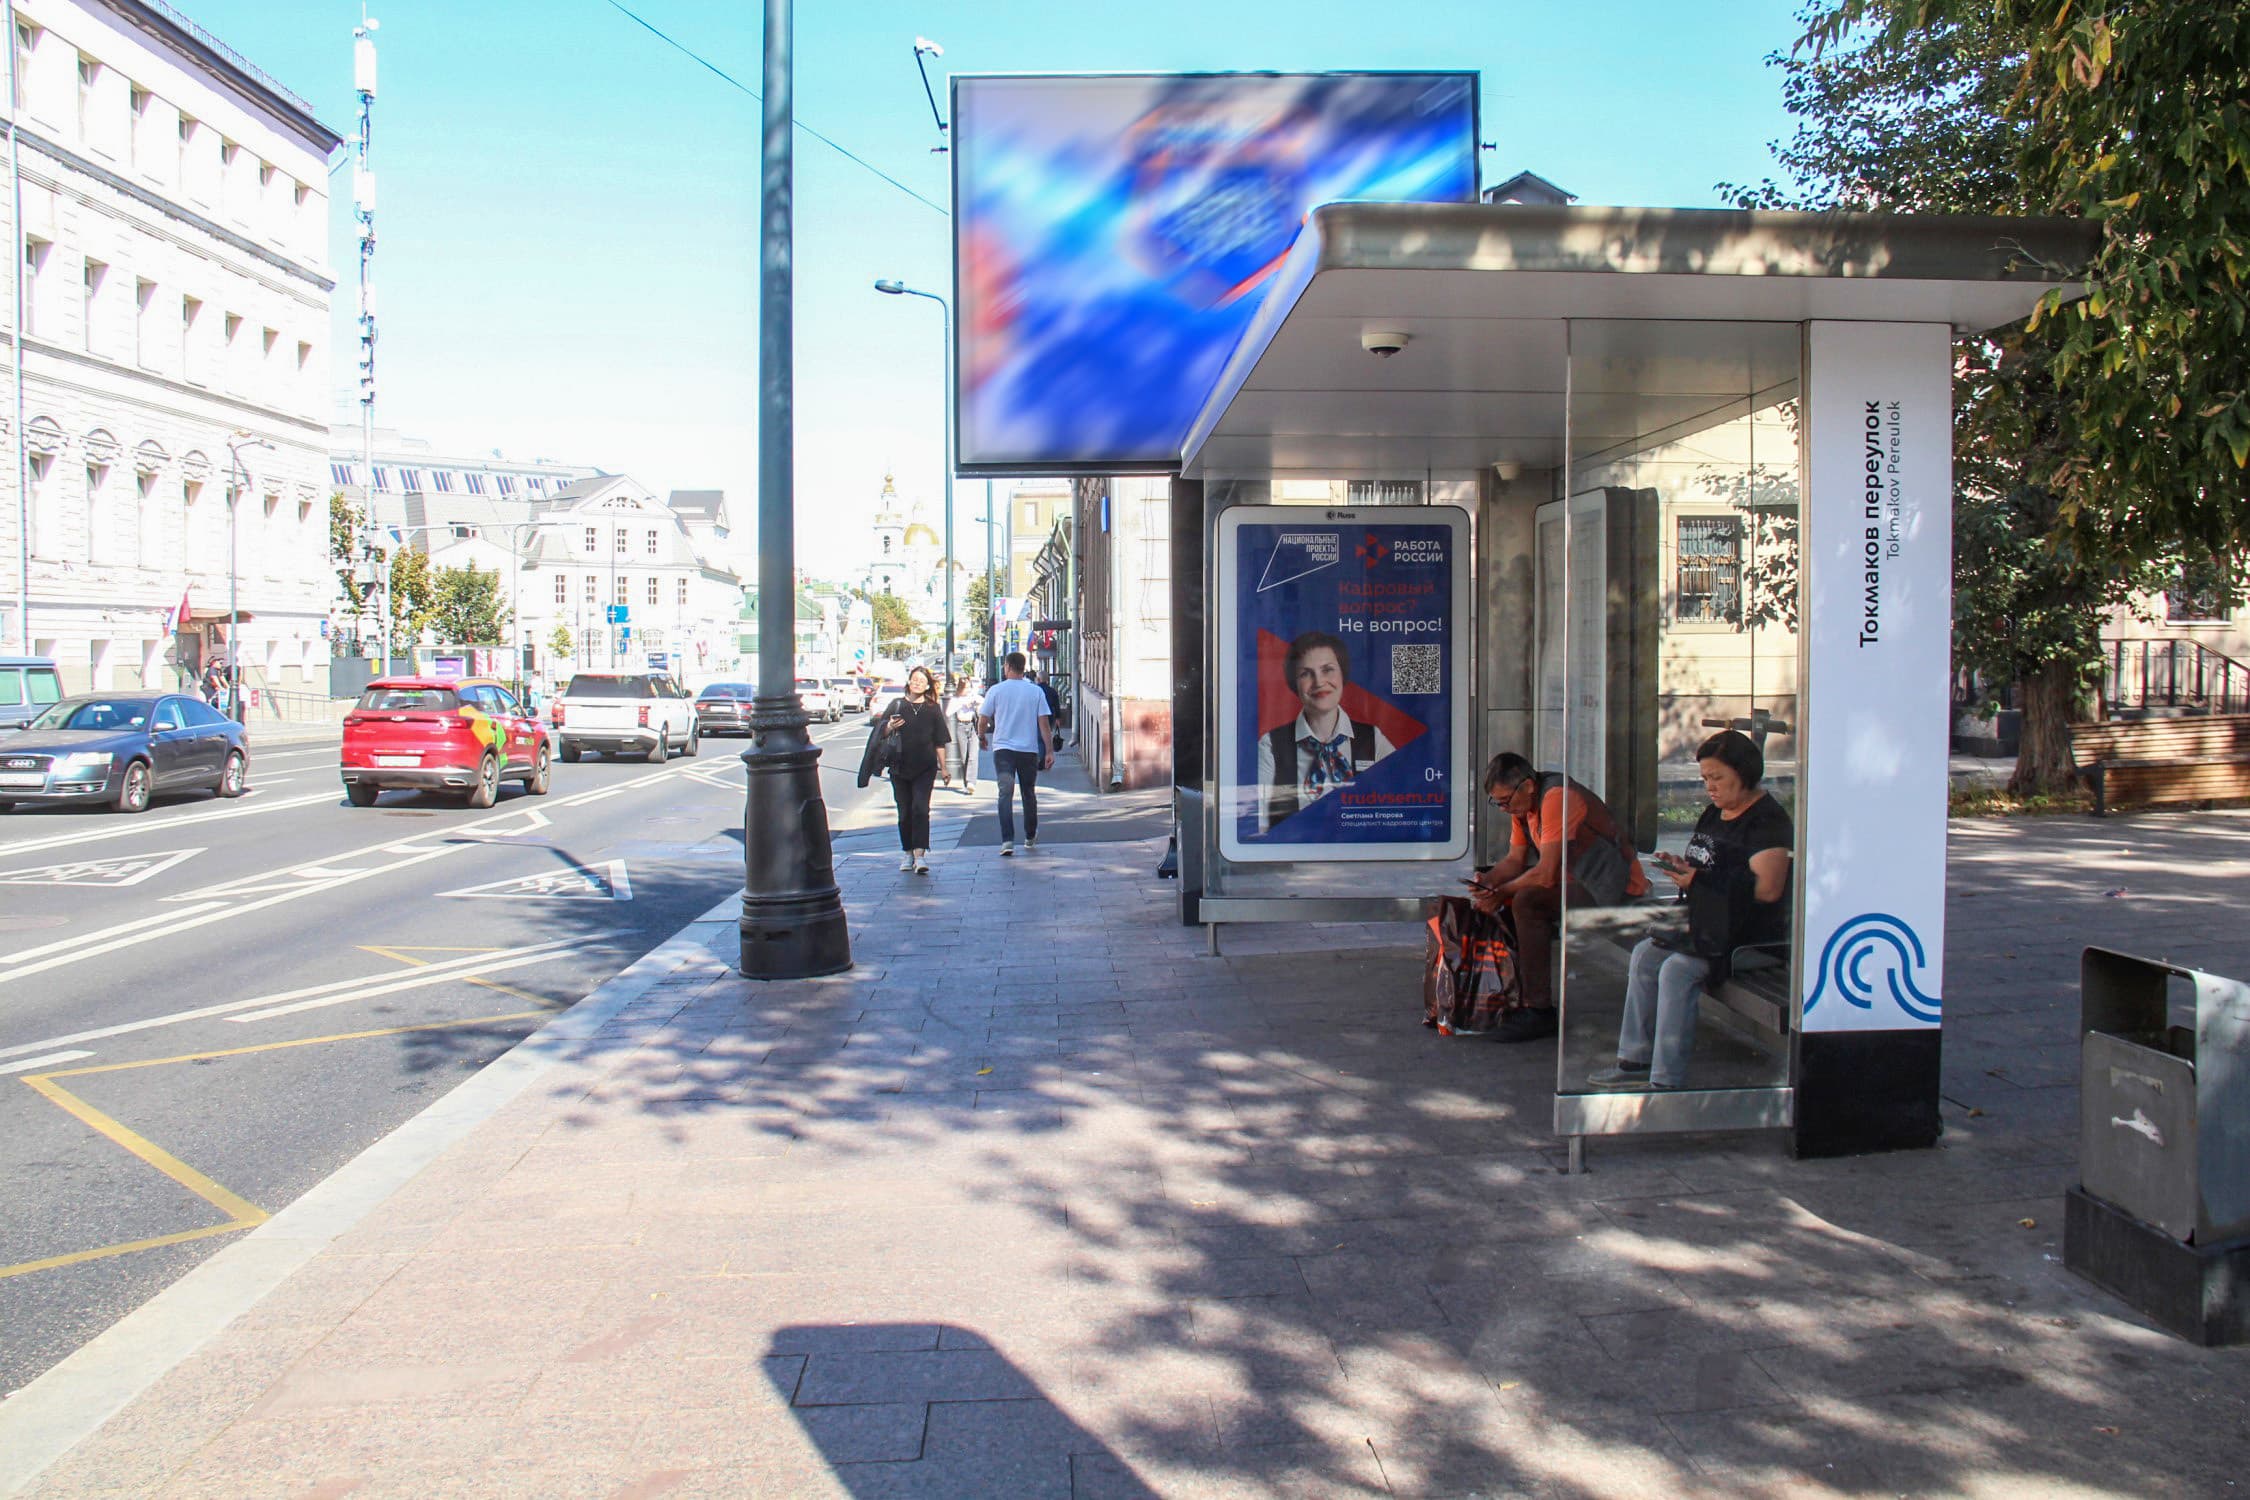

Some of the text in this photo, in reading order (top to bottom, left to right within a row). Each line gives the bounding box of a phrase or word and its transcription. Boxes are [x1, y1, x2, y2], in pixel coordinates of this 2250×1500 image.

[1886, 400, 1900, 560] Tokmakov Pereulok
[1860, 400, 1884, 648] Токмаков переулок
[1283, 535, 1337, 545] НАЦИОНАЛЬНЫЕ
[1394, 541, 1441, 551] РАБОТА
[1306, 545, 1337, 553] ПРОЕКТЫ
[1311, 553, 1337, 562] РОССИИ
[1394, 553, 1443, 562] РОССИИ
[1339, 581, 1434, 596] Кадровый
[1339, 599, 1418, 617] вопрос?
[1339, 617, 1442, 634] Не вопрос!
[1425, 767, 1444, 782] 0+
[1341, 791, 1445, 805] trudvsem.ru
[1341, 812, 1403, 820] Светлана Егорова
